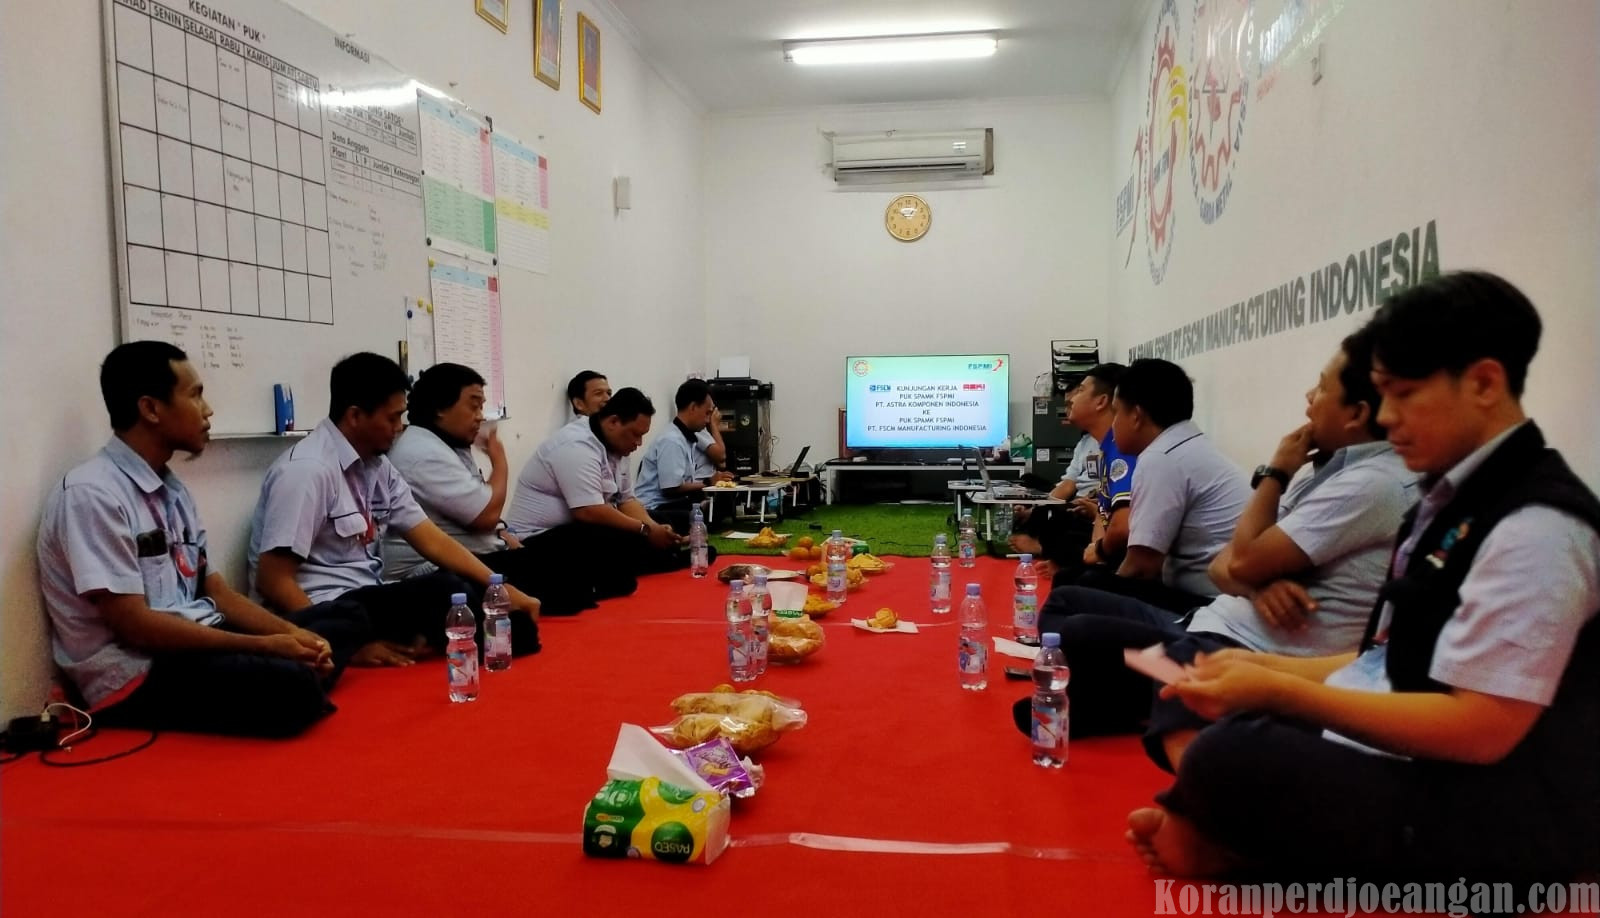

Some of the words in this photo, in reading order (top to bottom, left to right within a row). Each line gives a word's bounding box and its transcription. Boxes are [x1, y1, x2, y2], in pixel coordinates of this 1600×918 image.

[153, 5, 182, 27] SENIN
[188, 0, 236, 31] KEGIATAN
[185, 17, 215, 41] SELASA
[219, 34, 241, 54] RABU
[334, 37, 370, 64] INFORMASI
[246, 47, 270, 66] KAMIS
[332, 131, 346, 144] Data
[346, 138, 370, 154] Anggota
[1206, 275, 1304, 351] MANUFACTURING
[654, 841, 690, 855] PASEO
